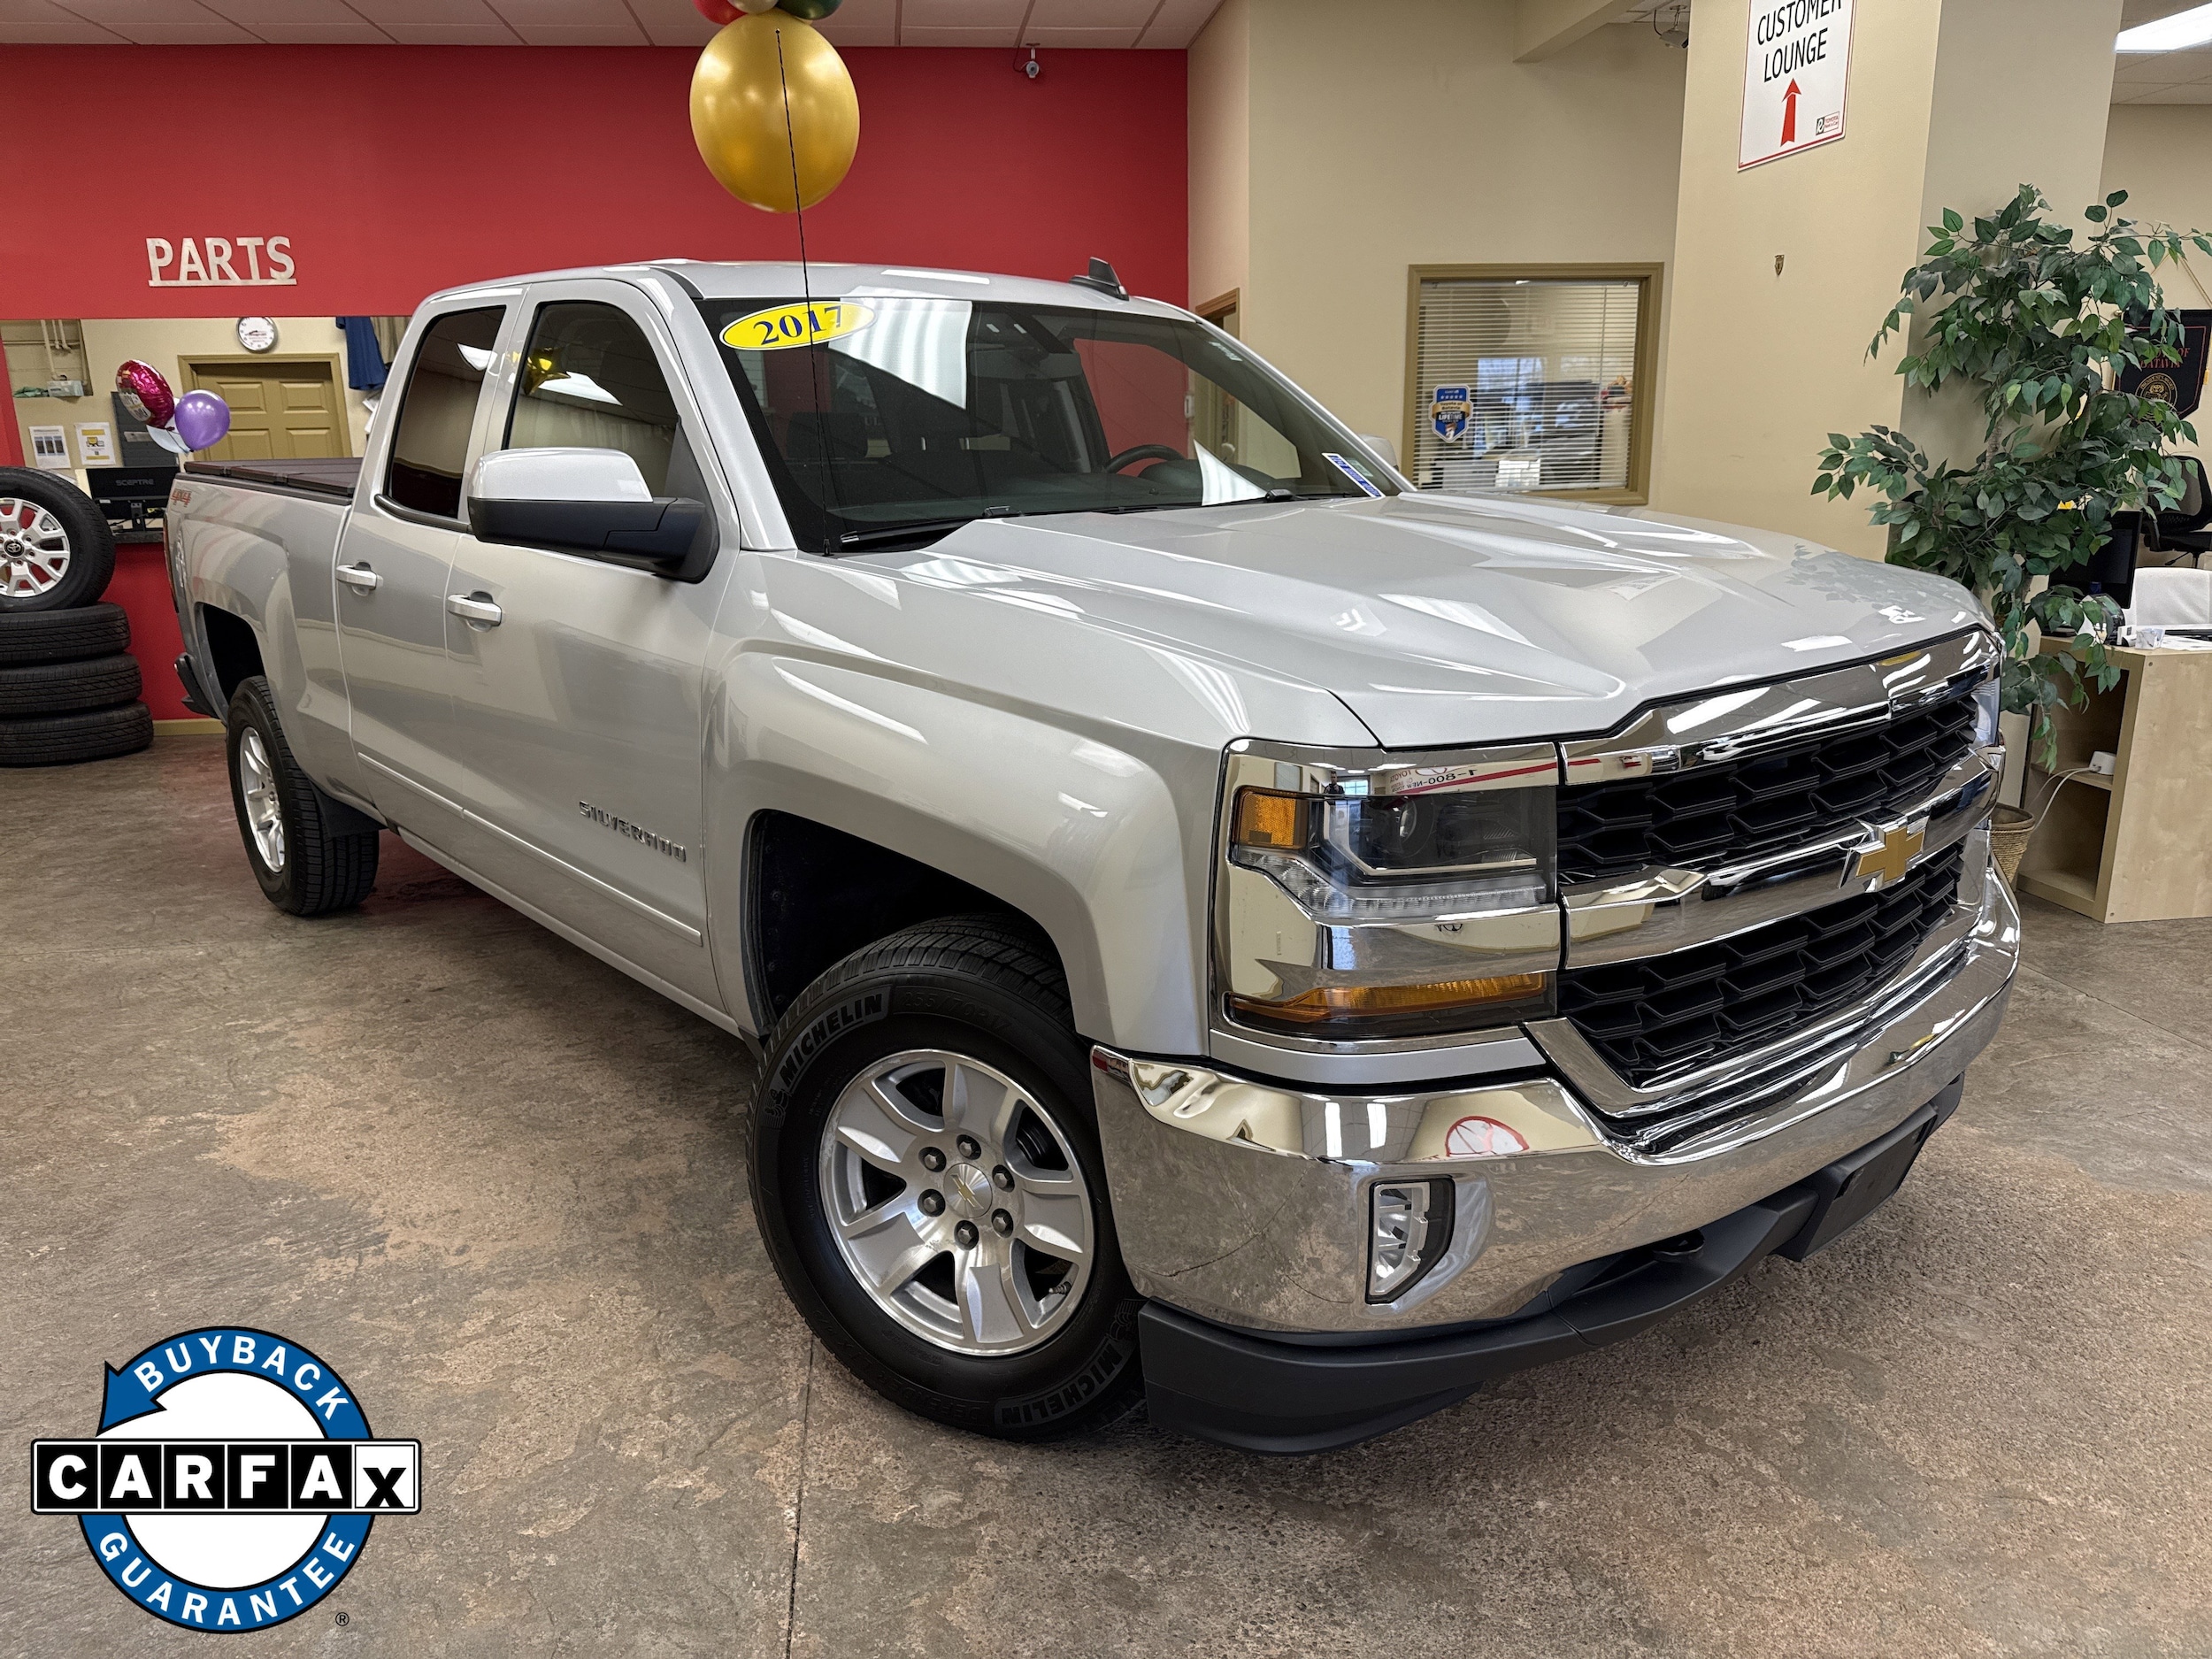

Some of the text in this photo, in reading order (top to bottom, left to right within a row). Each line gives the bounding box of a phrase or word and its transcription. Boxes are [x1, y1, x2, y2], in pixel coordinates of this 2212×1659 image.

[1763, 27, 1829, 82] LOUNGE
[146, 235, 297, 283] PARTS
[753, 304, 841, 346] 2017
[579, 800, 687, 863] SILVERADO
[779, 993, 883, 1088] MICHELIN
[1000, 1342, 1125, 1425] MICHELIN
